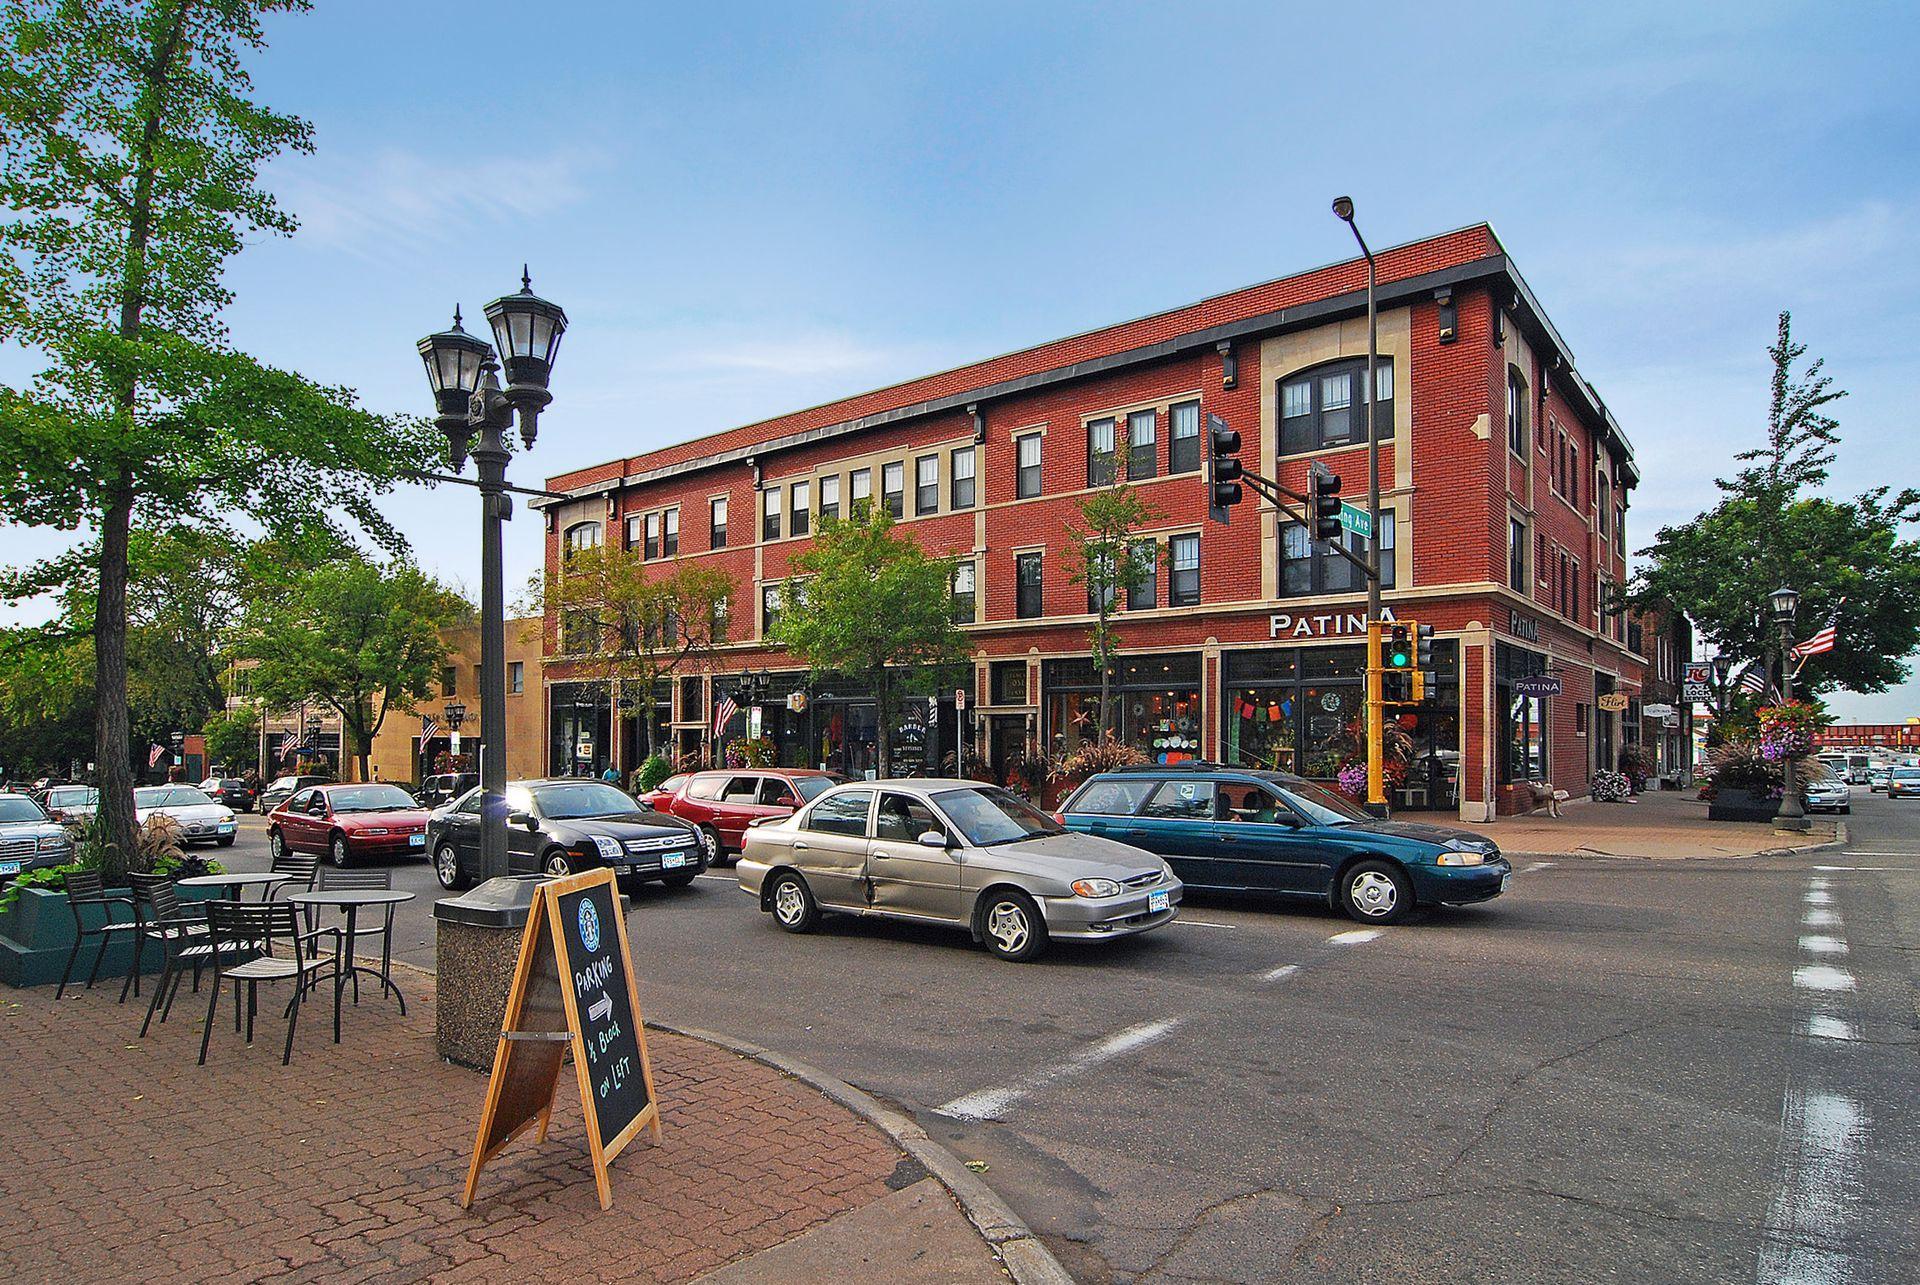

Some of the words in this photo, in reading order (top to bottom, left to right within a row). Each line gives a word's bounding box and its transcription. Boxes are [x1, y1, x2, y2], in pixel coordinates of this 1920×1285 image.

[1355, 515, 1369, 531] Ave
[1269, 607, 1396, 637] PATINA
[1511, 610, 1539, 642] PATINA
[1516, 683, 1560, 691] PATINA
[1601, 697, 1625, 706] Flirt
[575, 955, 613, 998] PARKING
[611, 1056, 630, 1090] LEFT
